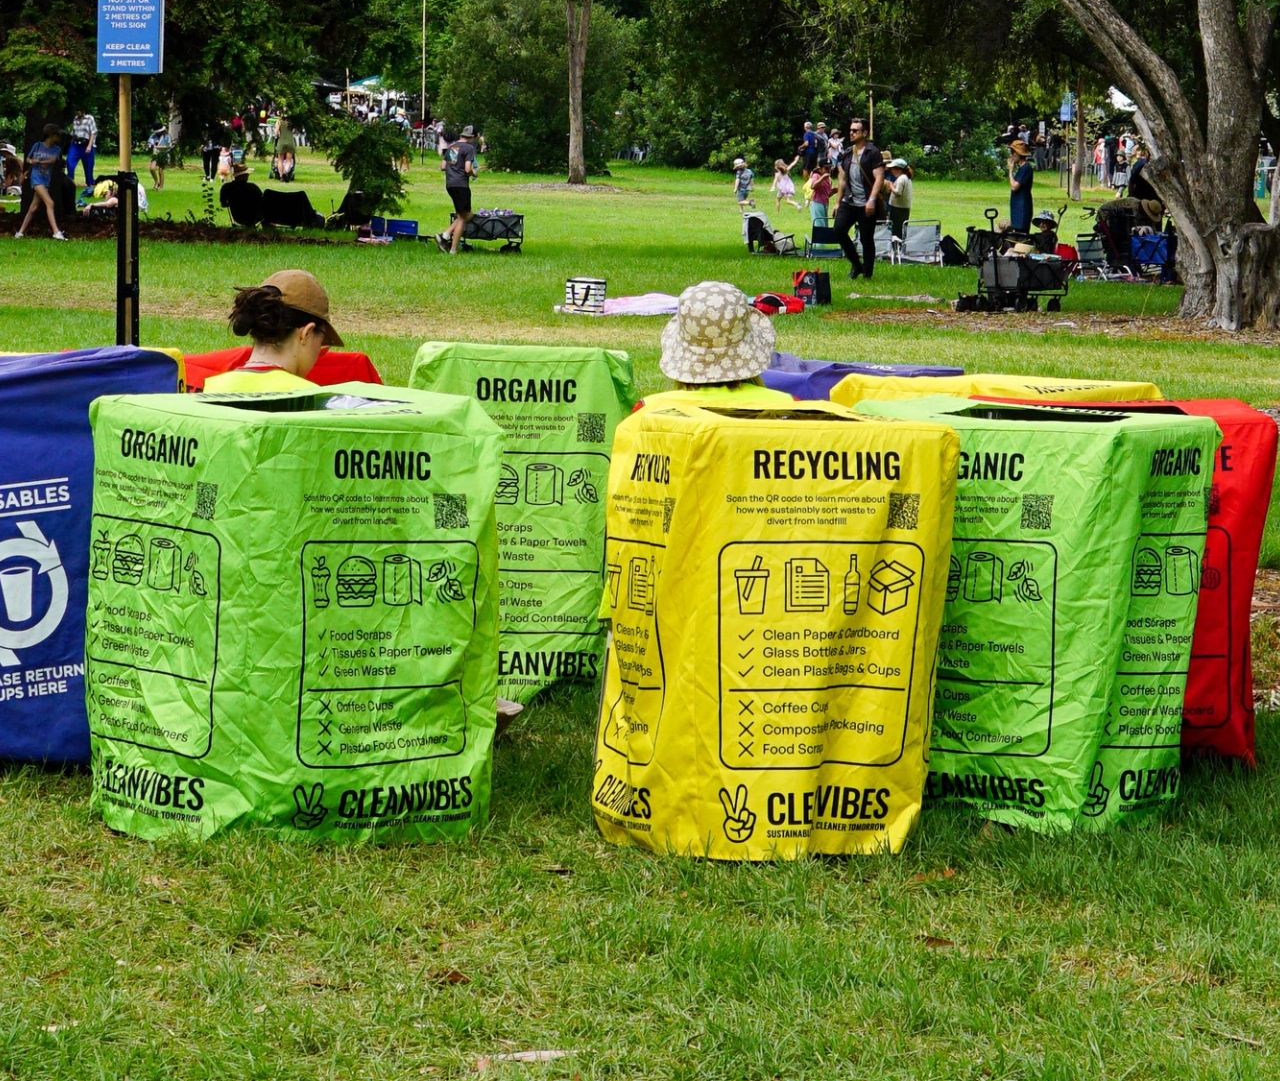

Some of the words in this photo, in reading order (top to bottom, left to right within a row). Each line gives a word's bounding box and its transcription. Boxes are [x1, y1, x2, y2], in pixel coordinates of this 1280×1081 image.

[477, 377, 577, 403] ORGANIC
[121, 428, 198, 467] ORGANIC
[334, 449, 431, 481] ORGANIC
[753, 449, 901, 481] RECYCLING
[957, 452, 1025, 482] GANIC
[332, 494, 344, 503] QR
[346, 494, 361, 502] code
[364, 494, 371, 502] to
[406, 496, 429, 504] about
[726, 495, 747, 503] Scan
[749, 495, 764, 503] the
[766, 495, 778, 503] QR
[781, 495, 802, 503] code
[805, 495, 813, 503] to
[816, 495, 836, 503] learn
[838, 495, 860, 503] more
[862, 495, 885, 503] about
[336, 506, 376, 515] sustainably
[736, 506, 755, 514] how
[757, 506, 769, 514] we
[771, 506, 820, 515] sustainably
[822, 506, 838, 514] sort
[840, 506, 865, 514] waste
[867, 506, 876, 514] to
[1001, 506, 1009, 514] to
[355, 517, 371, 525] from
[767, 517, 792, 525] divert
[794, 517, 815, 525] from
[497, 522, 533, 534] Scraps
[510, 538, 517, 547] &
[520, 538, 549, 547] Paper
[552, 538, 587, 547] Towels
[503, 552, 534, 561] Waste
[506, 580, 533, 590] Cups
[510, 598, 543, 608] Waste
[505, 614, 529, 623] Food
[532, 614, 588, 624] Containers
[1145, 617, 1176, 629] Scraps
[138, 626, 164, 641] Paper
[763, 629, 800, 641] Clean
[803, 629, 838, 642] Paper
[838, 628, 844, 639] &
[845, 627, 899, 640] Cardboard
[942, 625, 968, 634] craps
[330, 630, 354, 641] Food
[356, 630, 392, 642] Scraps
[1124, 634, 1156, 645] Tissues
[1157, 634, 1164, 645] &
[1166, 634, 1191, 646] Paper
[332, 647, 367, 659] Tissues
[370, 648, 376, 658] &
[379, 646, 413, 659] Paper
[413, 645, 452, 656] Towels
[763, 647, 799, 658] Glass
[802, 646, 837, 658] Bottles
[838, 646, 844, 656] &
[845, 645, 866, 655] Jars
[947, 642, 953, 651] &
[955, 641, 985, 652] Paper
[988, 642, 1024, 653] Towels
[939, 655, 970, 668] Waste
[1122, 651, 1151, 662] Green
[1152, 651, 1181, 662] Waste
[334, 666, 359, 677] Green
[362, 665, 396, 676] Waste
[498, 651, 598, 679] EANVIBES
[763, 665, 800, 677] Clean
[856, 663, 864, 673] &
[867, 663, 901, 679] Cups
[25, 663, 85, 685] RETURN
[98, 673, 129, 686] Coffee
[28, 680, 68, 697] HERE
[1120, 685, 1156, 696] Coffee
[1158, 685, 1180, 697] Cups
[944, 690, 970, 701] Cups
[336, 701, 366, 713] Coffee
[368, 700, 394, 712] Cups
[763, 701, 808, 713] Coffee
[947, 711, 977, 722] Waste
[338, 723, 370, 734] General
[373, 721, 402, 732] Waste
[829, 719, 884, 735] Packaging
[1119, 724, 1153, 736] Plastic
[941, 729, 963, 739] Food
[966, 731, 1023, 743] Containers
[340, 743, 370, 754] Plastic
[373, 741, 396, 751] Food
[398, 734, 448, 749] Containers
[763, 744, 795, 755] Food
[923, 770, 1045, 807] EANVIBES
[338, 775, 473, 819] CLEANVIBES
[767, 785, 890, 825] CLEVIBES
[161, 811, 201, 823] TOMORROW
[815, 822, 846, 832] CLEANER
[848, 822, 886, 832] TOMORROW
